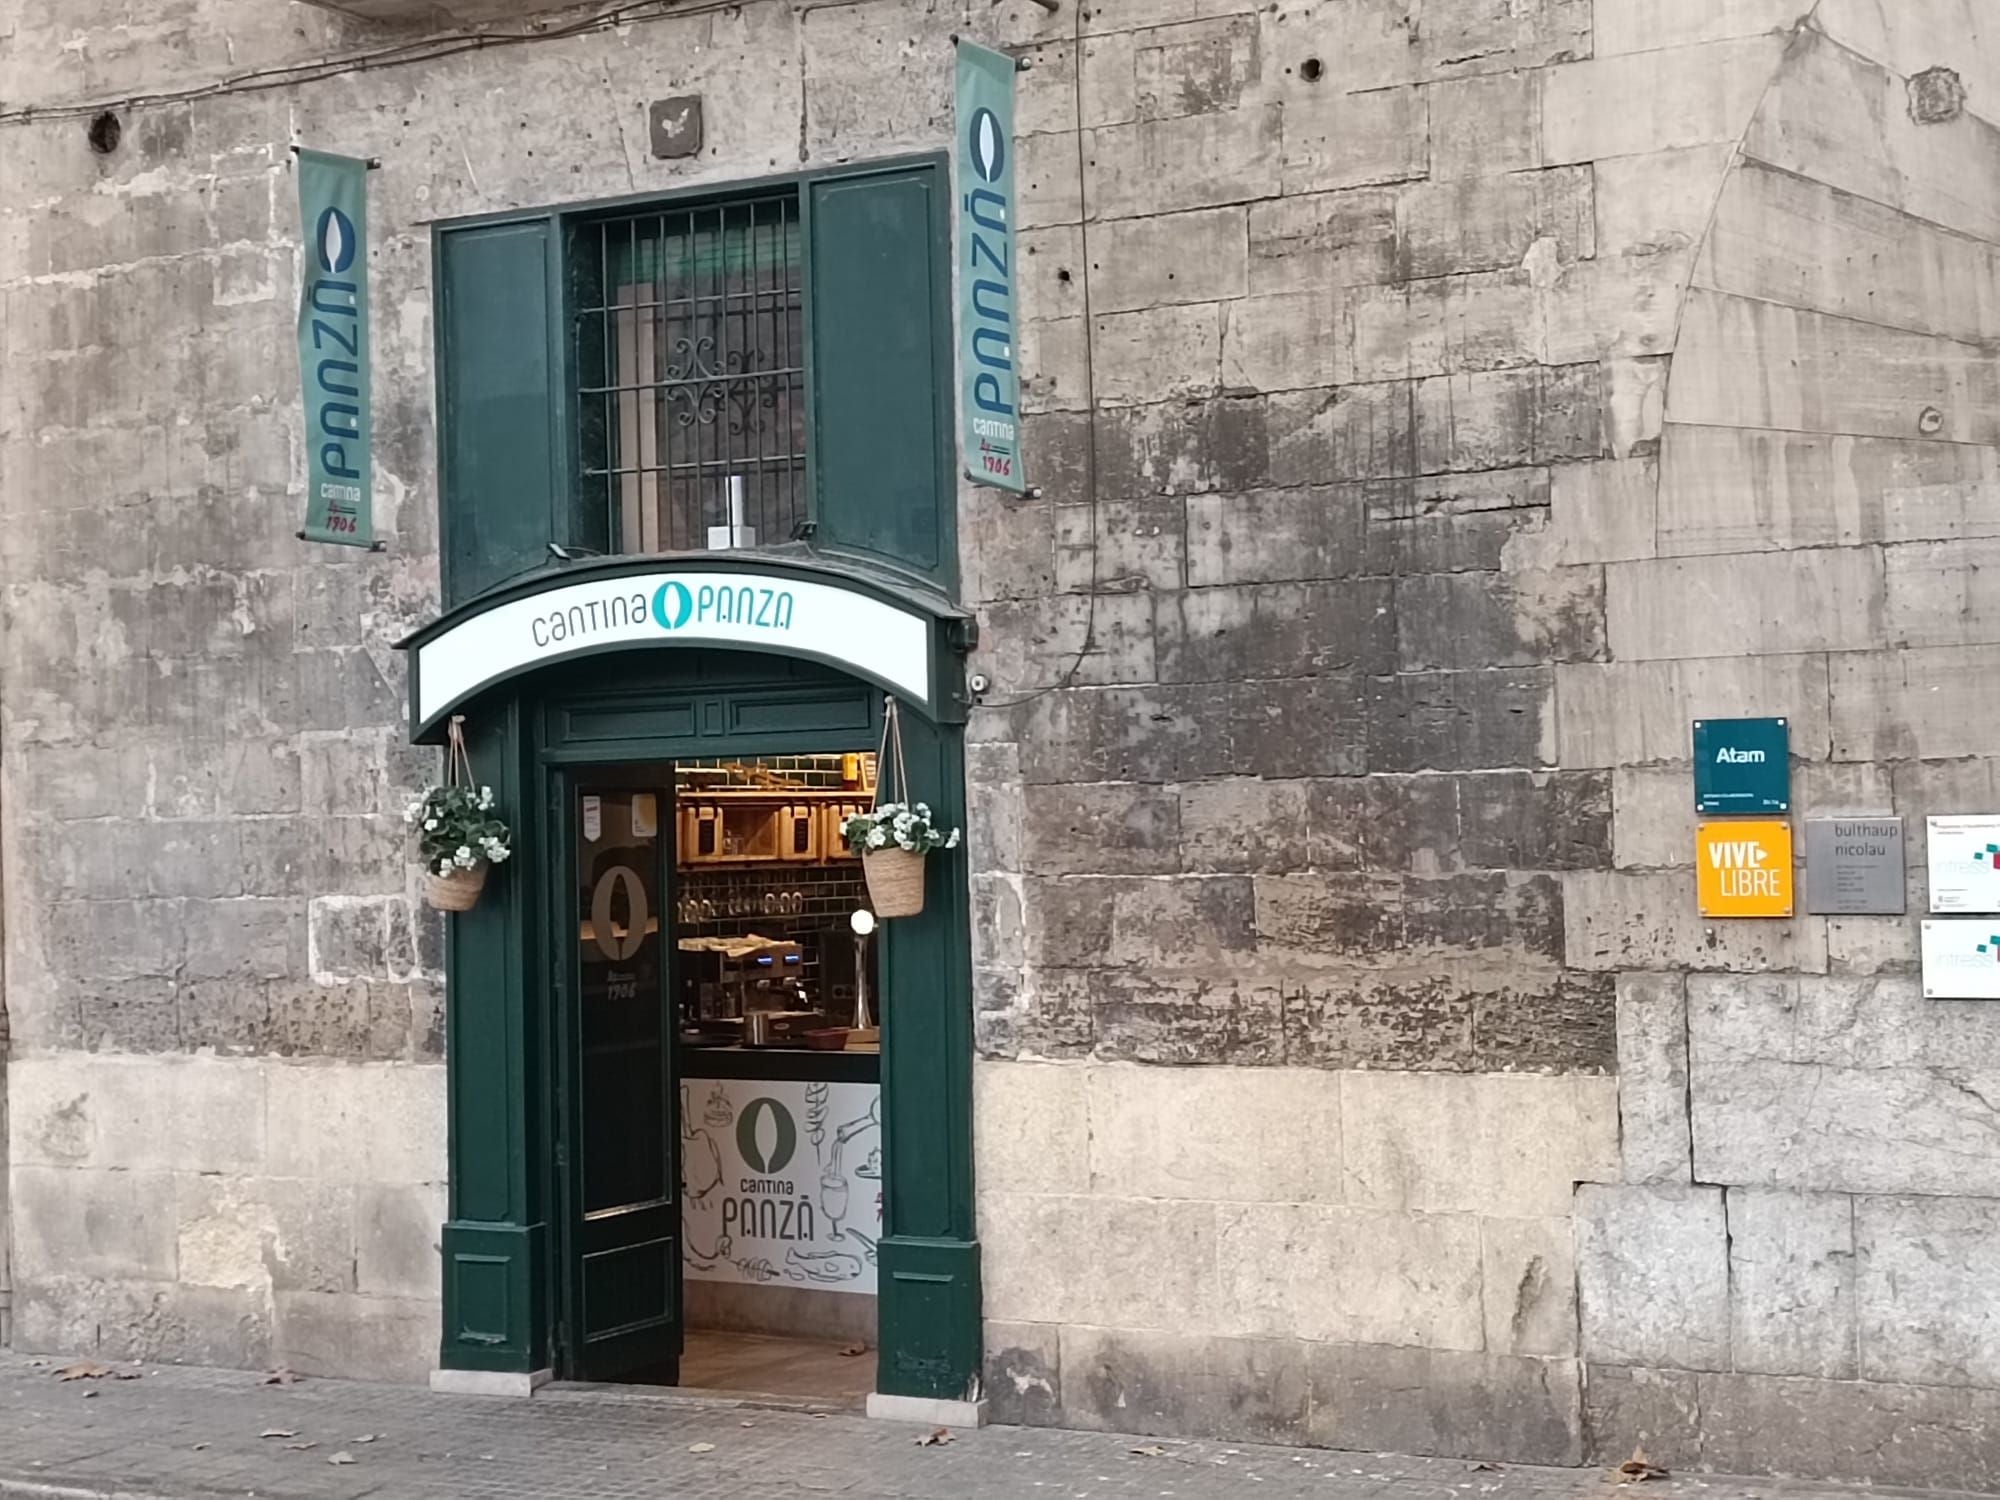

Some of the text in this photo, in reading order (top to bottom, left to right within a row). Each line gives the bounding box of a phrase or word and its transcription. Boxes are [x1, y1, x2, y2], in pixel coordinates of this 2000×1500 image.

[982, 456, 1011, 476] 1906
[325, 515, 357, 533] 1906
[1716, 747, 1766, 763] Atam
[1835, 823, 1898, 840] bulthaup
[1708, 841, 1761, 869] VIVE
[1835, 841, 1886, 857] nicolau
[1720, 869, 1781, 897] LIBRE
